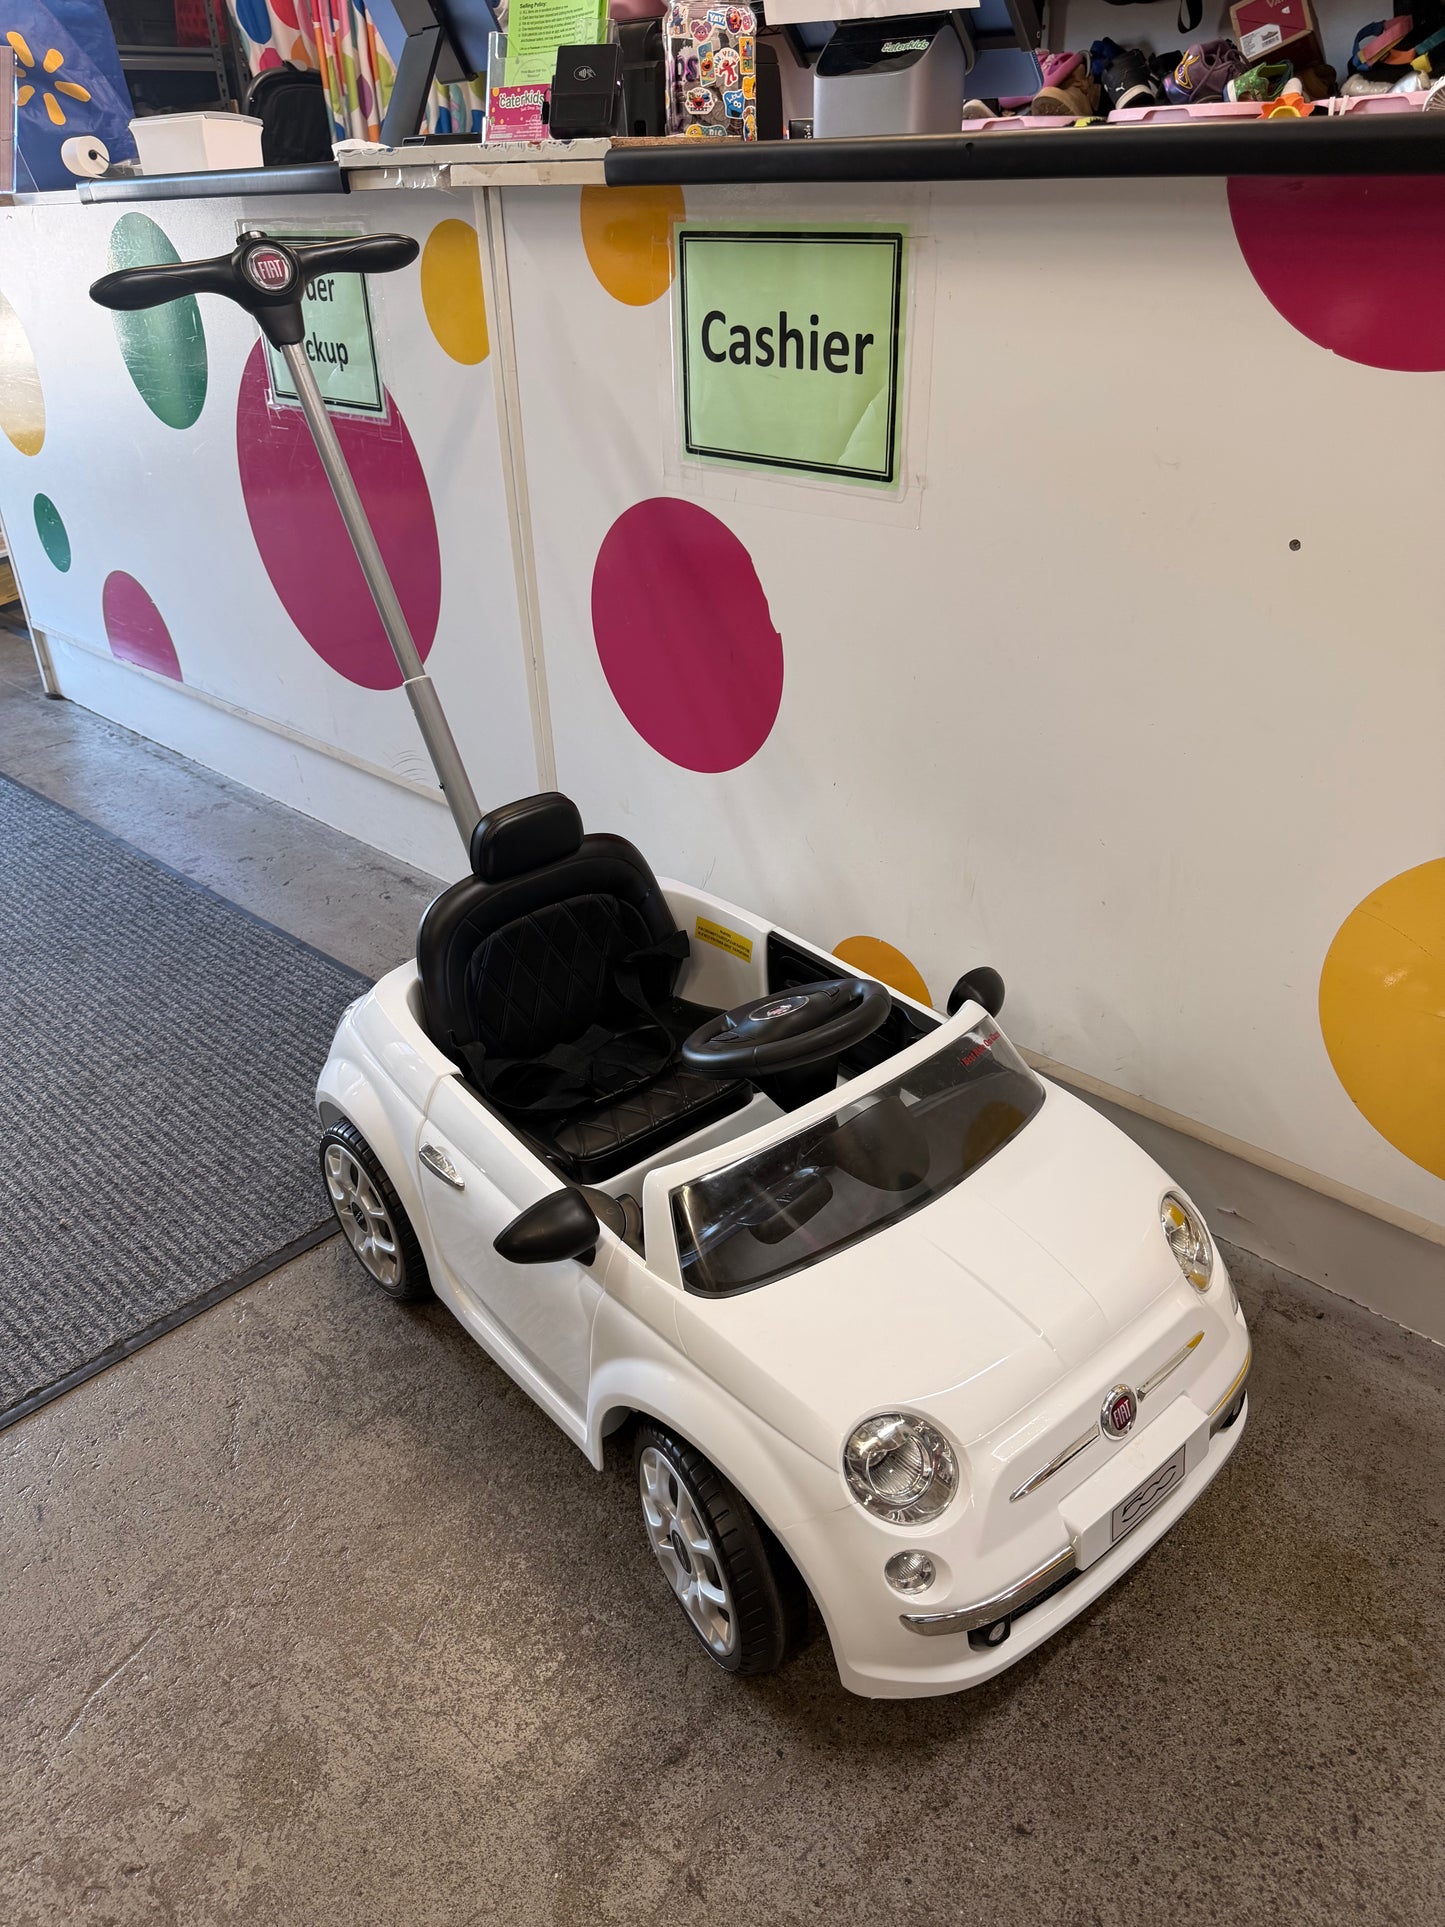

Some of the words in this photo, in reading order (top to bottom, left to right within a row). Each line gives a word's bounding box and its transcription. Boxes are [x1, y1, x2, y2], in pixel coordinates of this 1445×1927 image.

[257, 259, 283, 280] FIAT
[306, 277, 335, 302] der
[305, 332, 349, 372] ckup
[701, 310, 874, 375] Cashier
[1113, 1400, 1131, 1429] FIAT
